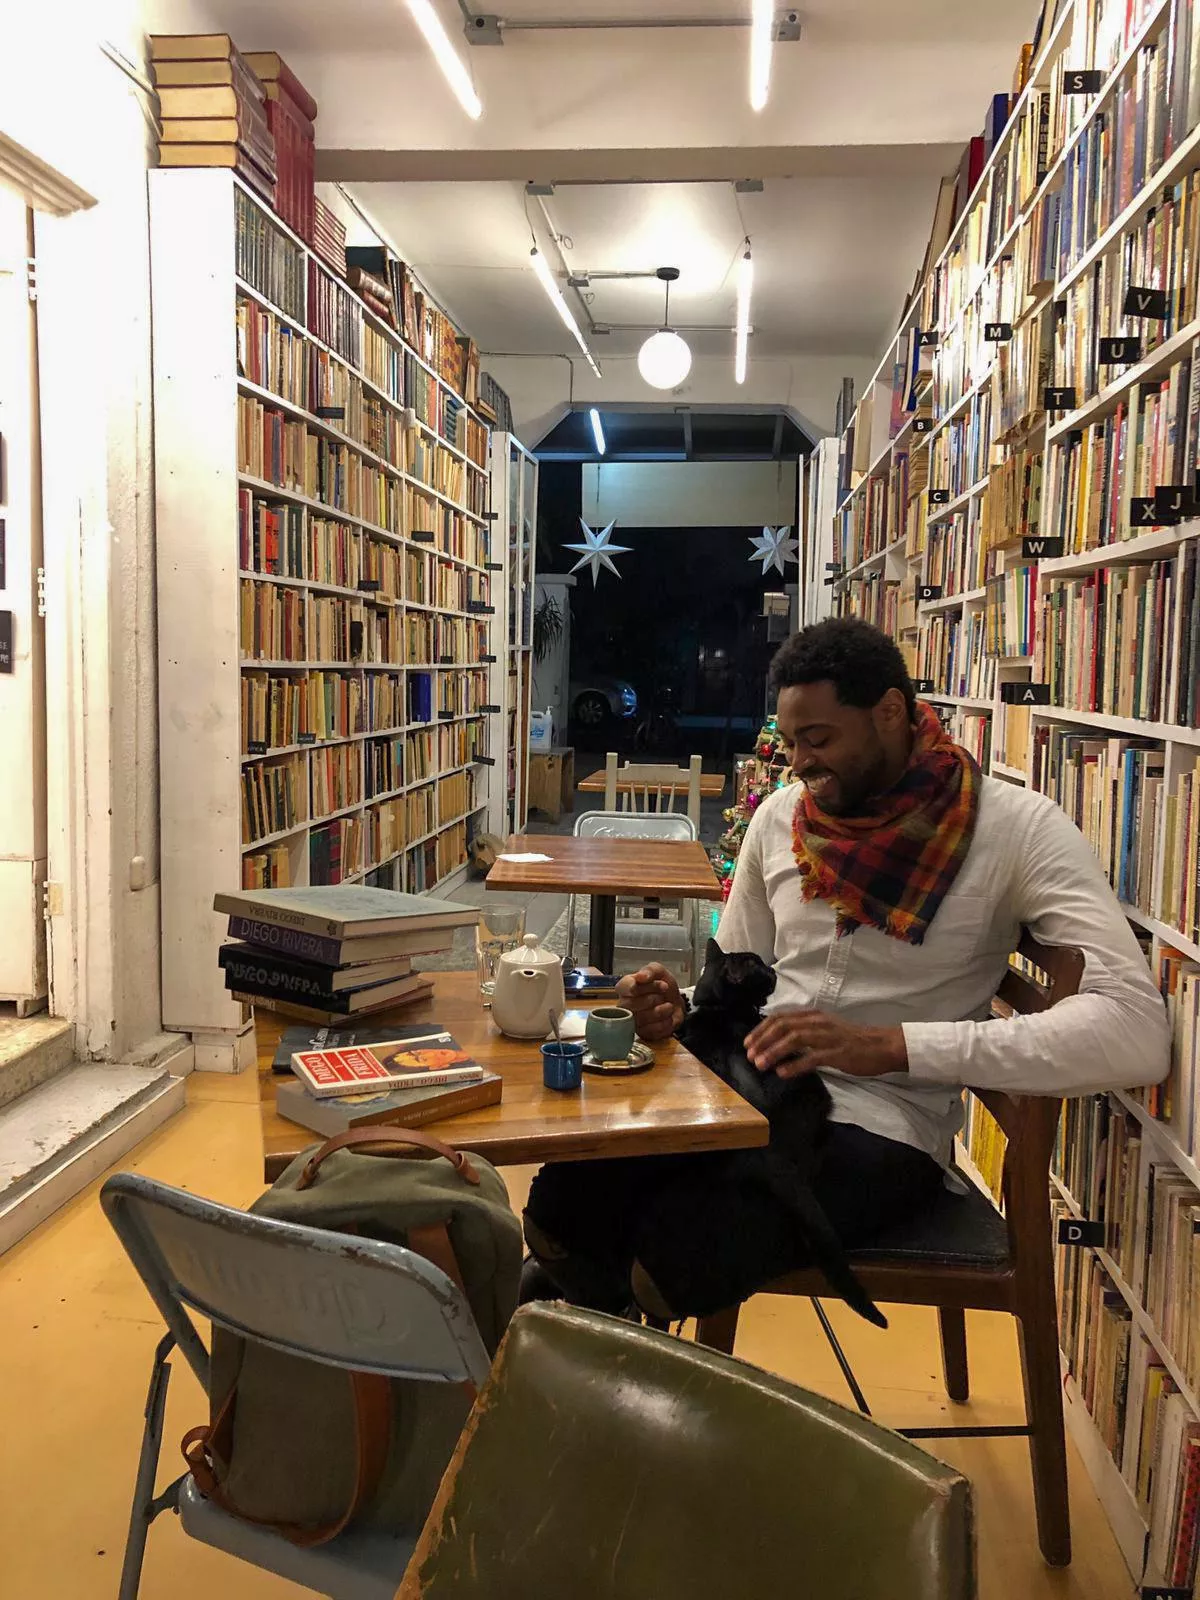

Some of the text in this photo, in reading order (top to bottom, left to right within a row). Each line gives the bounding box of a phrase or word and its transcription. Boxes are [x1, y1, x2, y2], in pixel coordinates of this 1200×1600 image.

[1073, 75, 1083, 90] S
[1137, 293, 1152, 311] V
[989, 326, 1002, 338] M
[921, 335, 929, 344] A
[1110, 343, 1125, 359] U
[1052, 392, 1064, 406] T
[917, 421, 924, 430] B
[933, 492, 942, 502] C
[1169, 492, 1181, 510] J
[1141, 503, 1156, 520] X
[1028, 541, 1045, 554] W
[923, 588, 932, 597] D
[919, 682, 927, 691] F
[1022, 688, 1036, 701] A
[241, 919, 324, 957] DIEGO RIVERA
[305, 1056, 336, 1081] DIEGO
[344, 1052, 374, 1075] FRIDA
[1068, 1226, 1082, 1241] D
